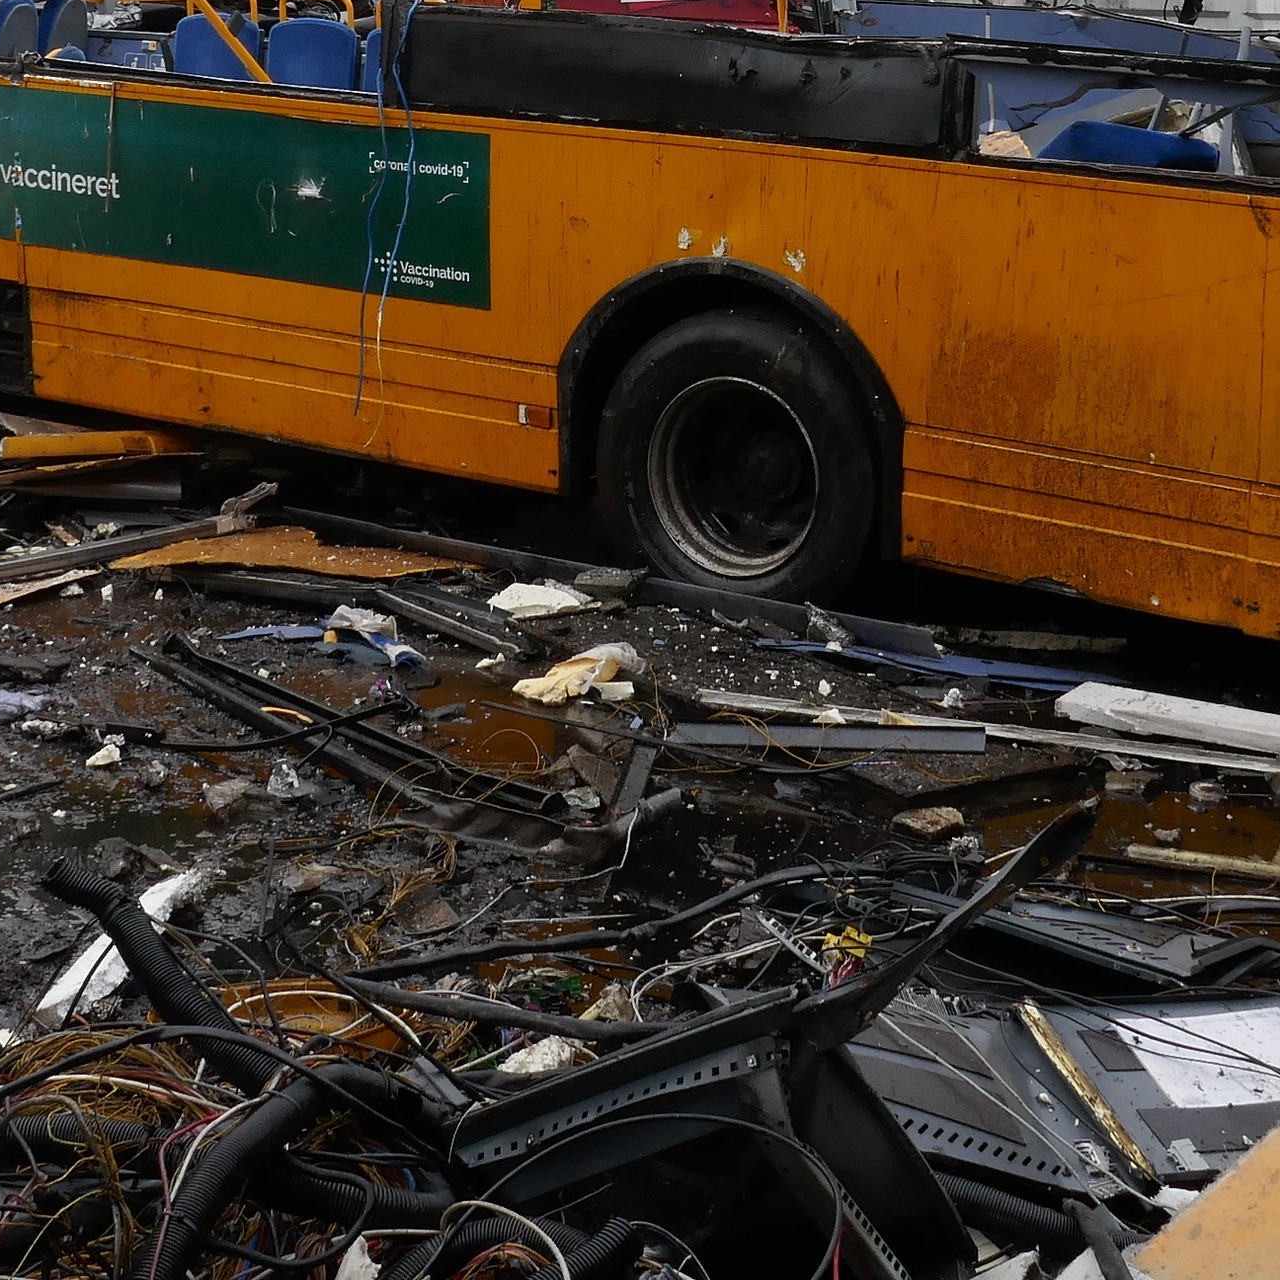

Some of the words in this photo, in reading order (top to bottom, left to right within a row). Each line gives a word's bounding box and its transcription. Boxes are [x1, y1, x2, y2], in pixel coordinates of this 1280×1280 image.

[418, 163, 464, 177] covid-19
[0, 164, 120, 199] vaccineret
[400, 260, 470, 282] Vaccination
[400, 275, 434, 288] COVID-19
